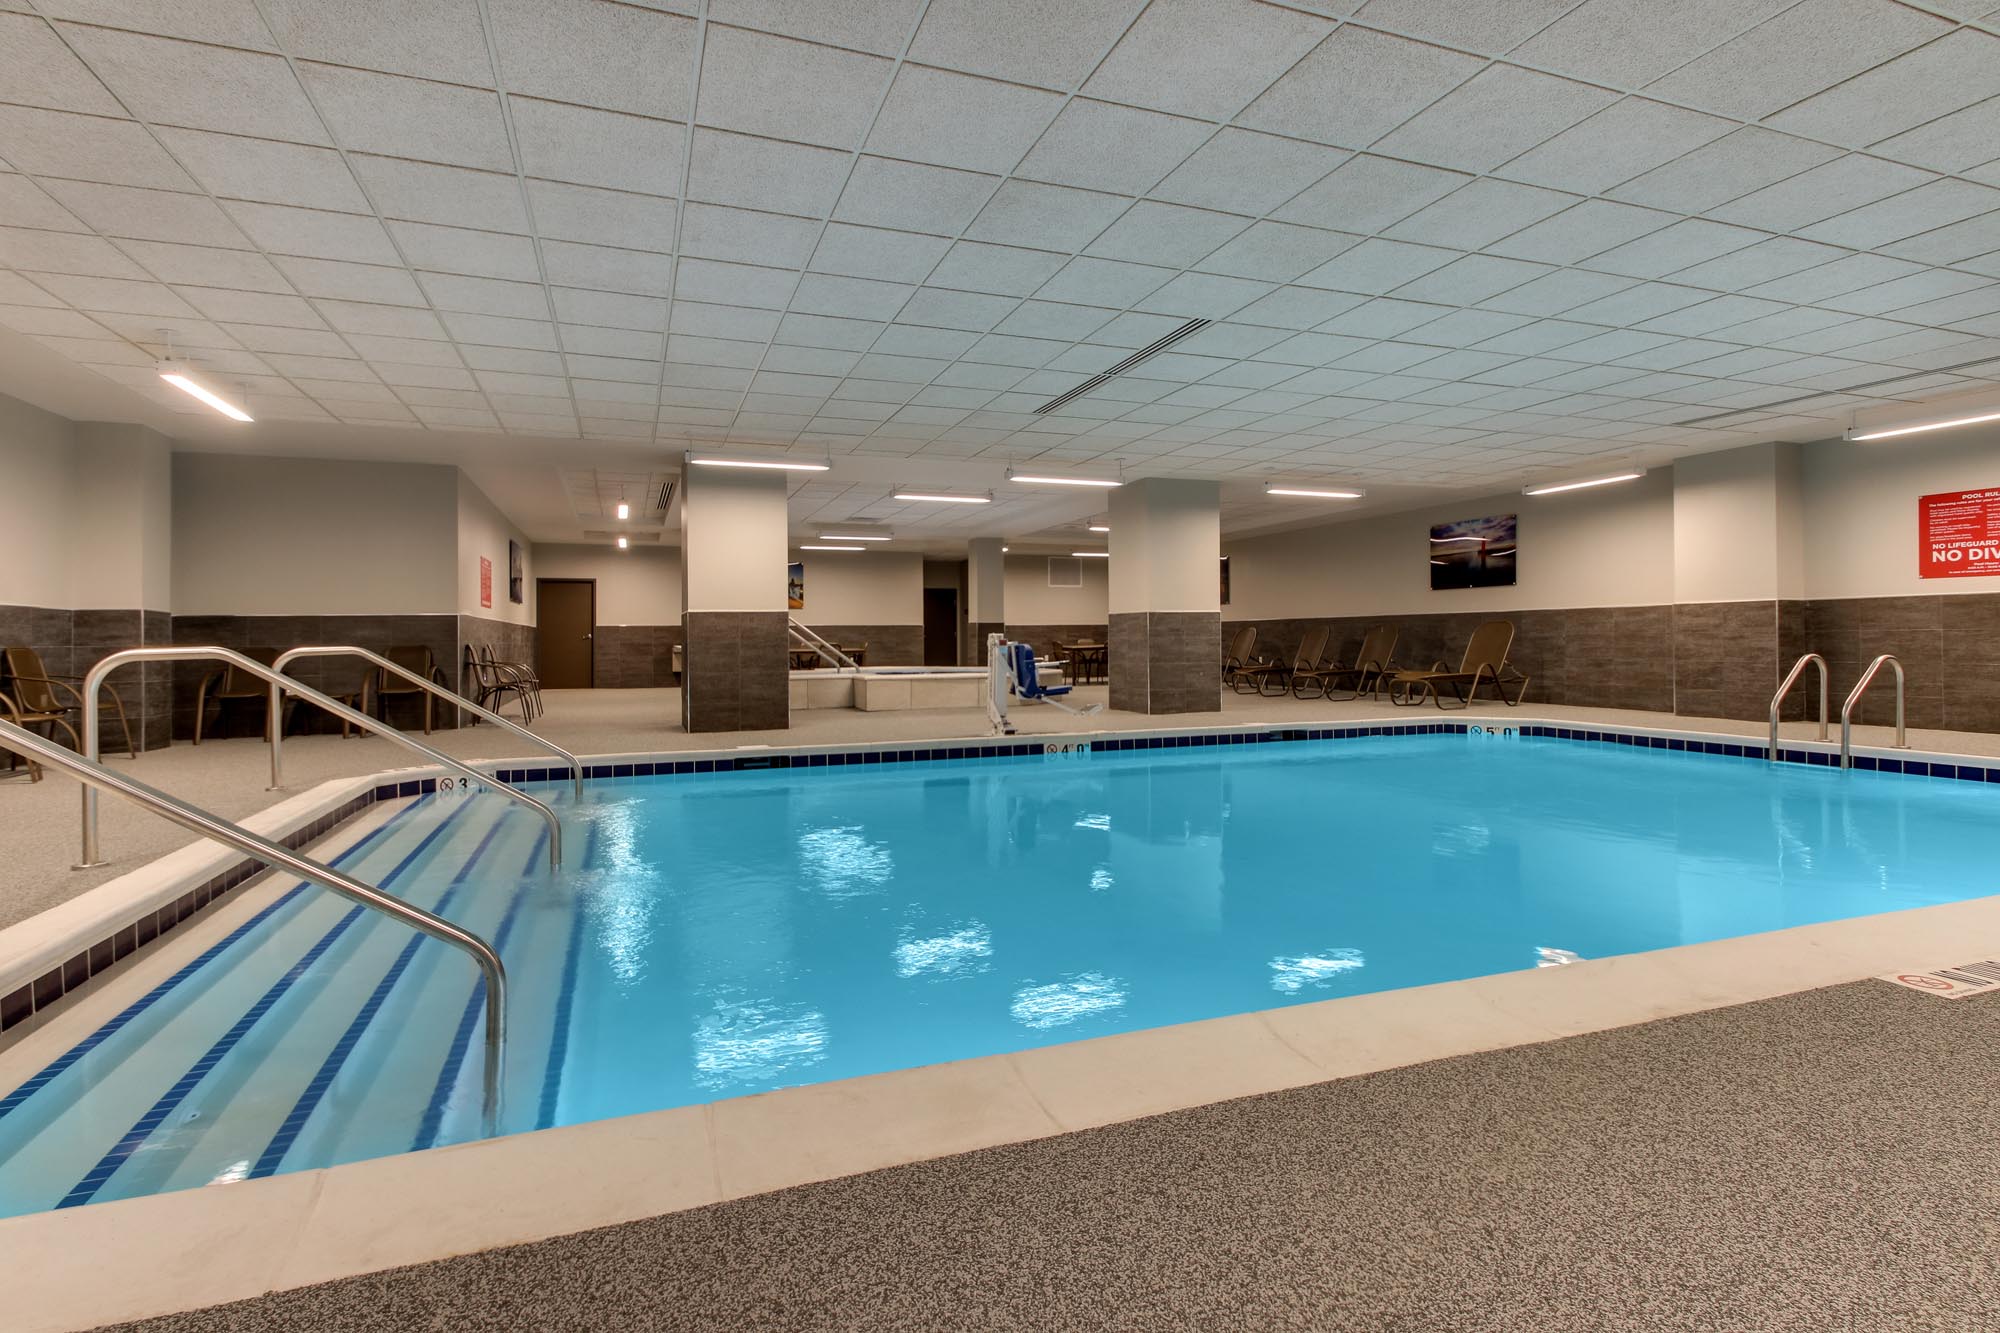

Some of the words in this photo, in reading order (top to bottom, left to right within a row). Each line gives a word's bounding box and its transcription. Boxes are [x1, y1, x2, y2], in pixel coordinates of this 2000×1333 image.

[1948, 540, 1998, 548] LIFEGUARD
[1932, 549, 1962, 563] NO
[459, 777, 468, 788] 3
